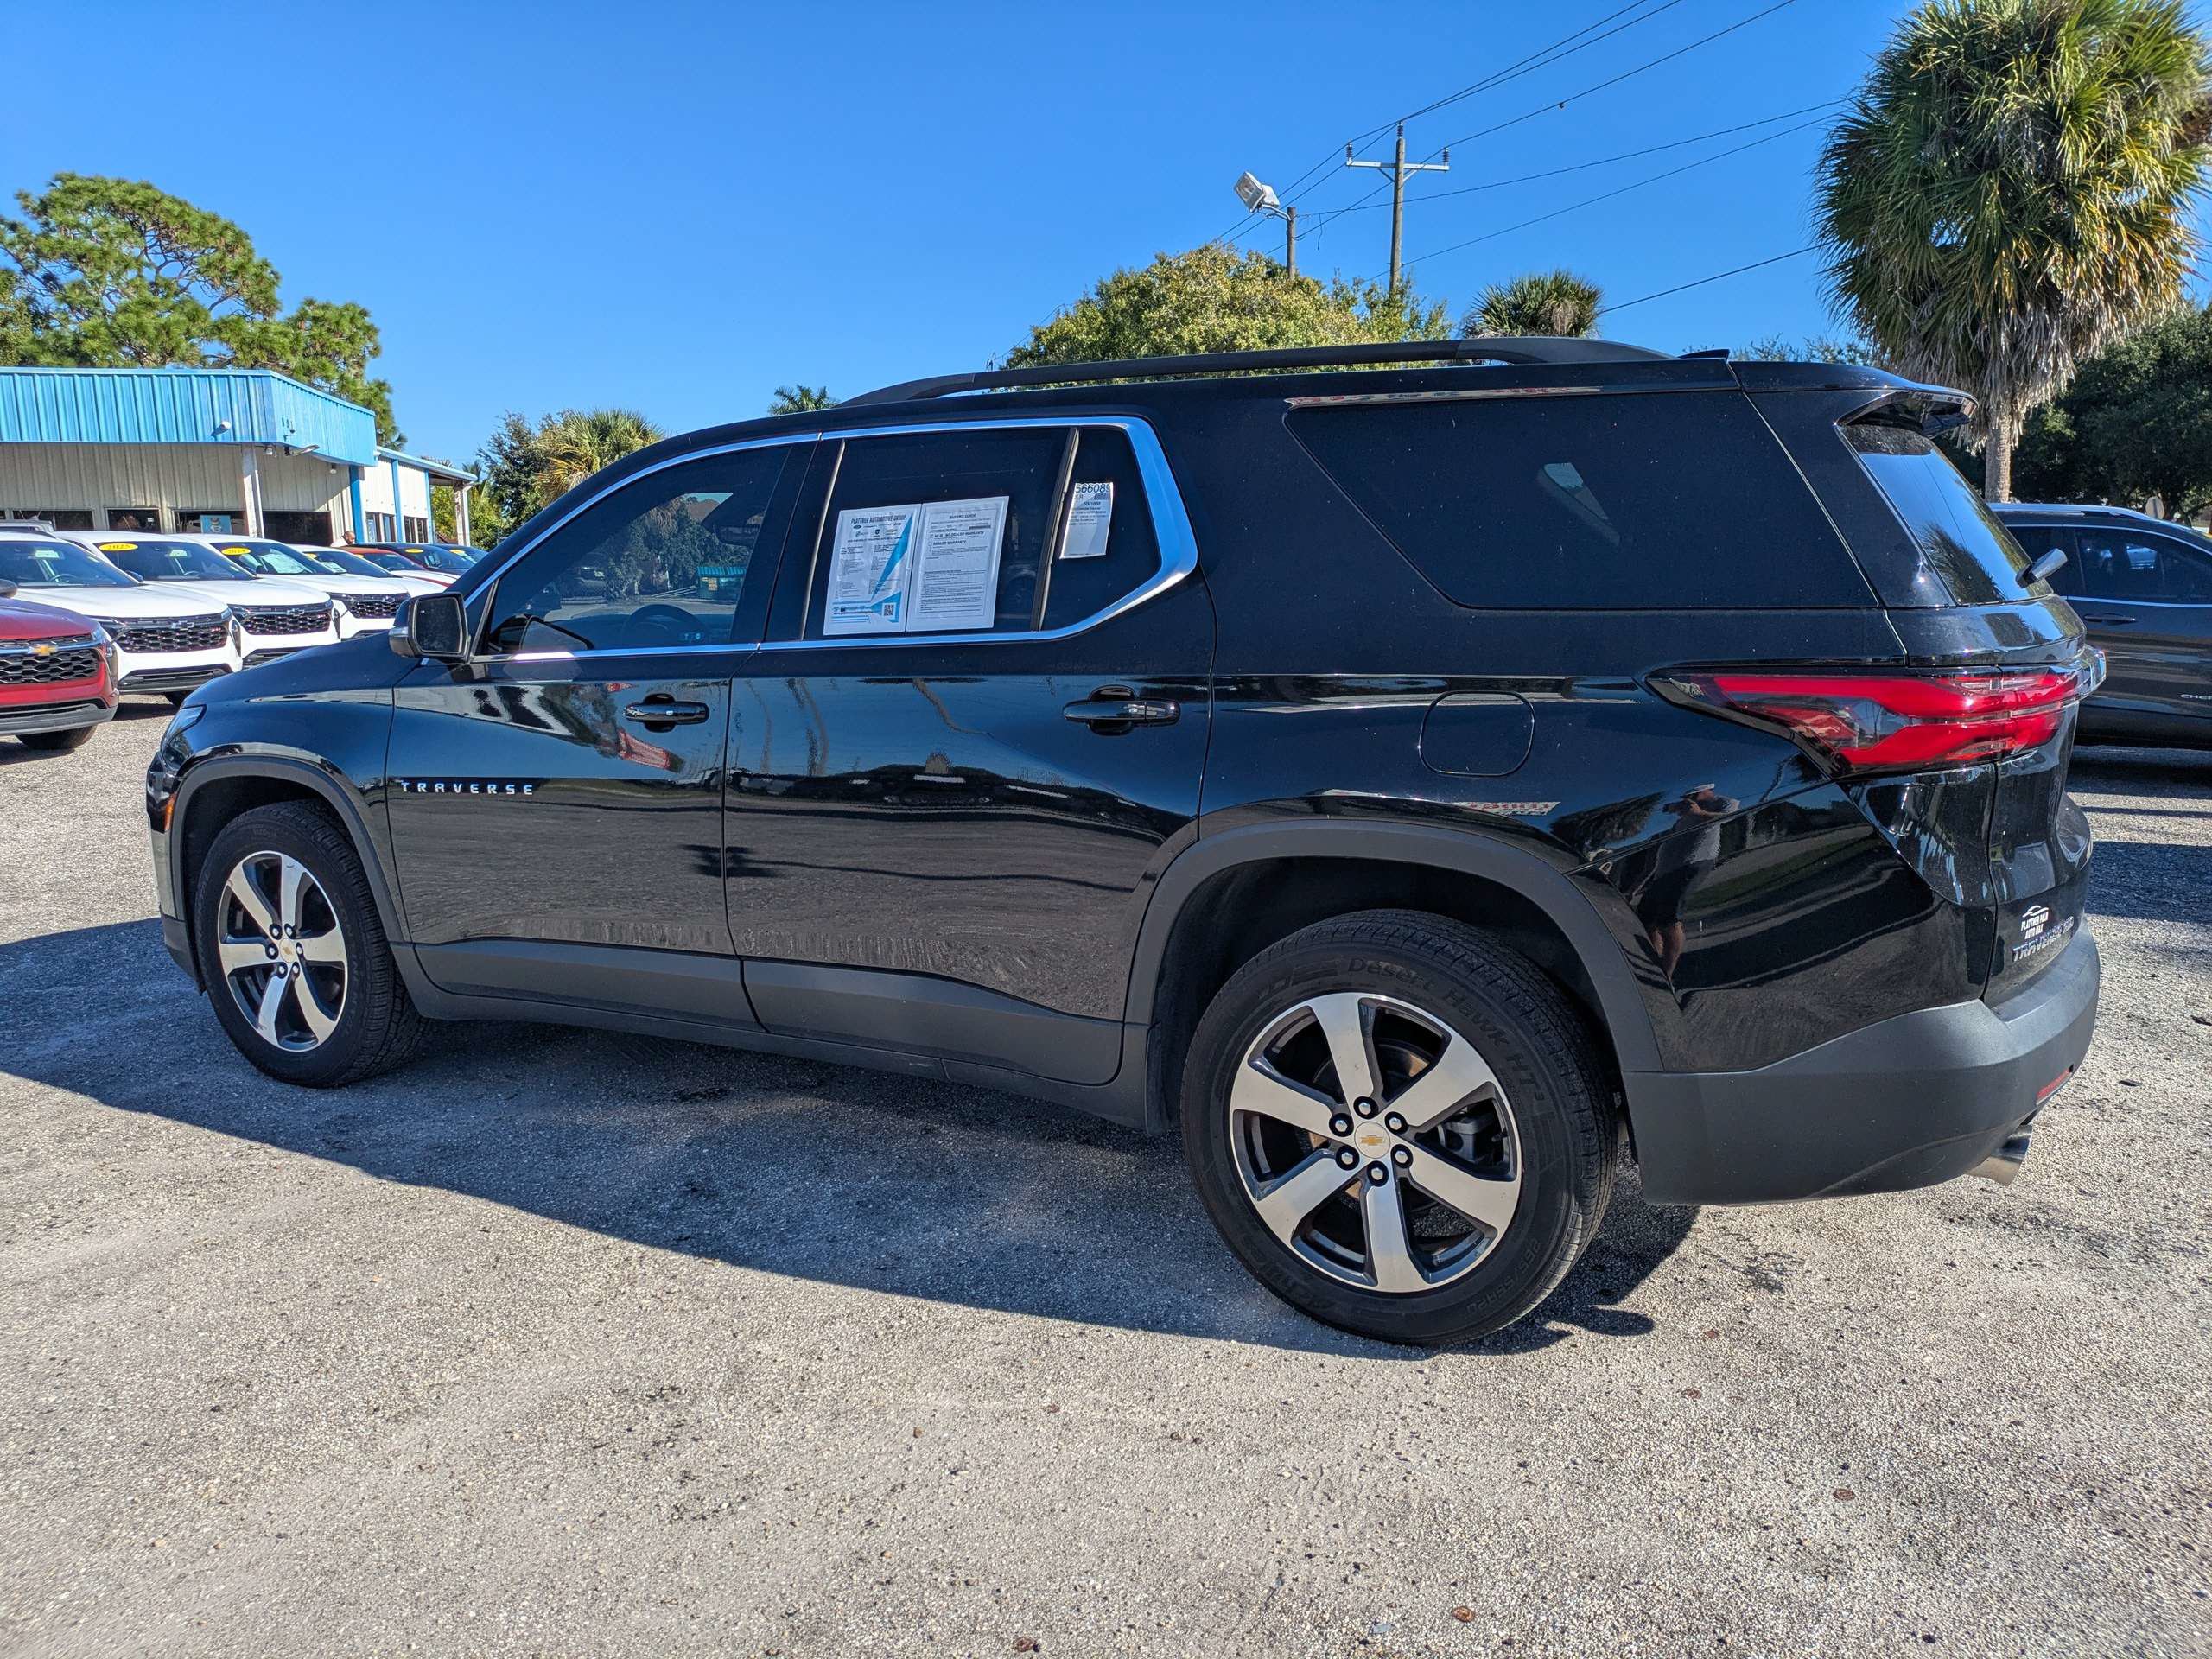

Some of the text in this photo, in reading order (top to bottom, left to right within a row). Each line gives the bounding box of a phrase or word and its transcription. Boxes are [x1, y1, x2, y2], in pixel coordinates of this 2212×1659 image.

[400, 782, 533, 795] TRAVERSE
[1348, 957, 1437, 992] Desert
[1446, 988, 1509, 1047] Hawk
